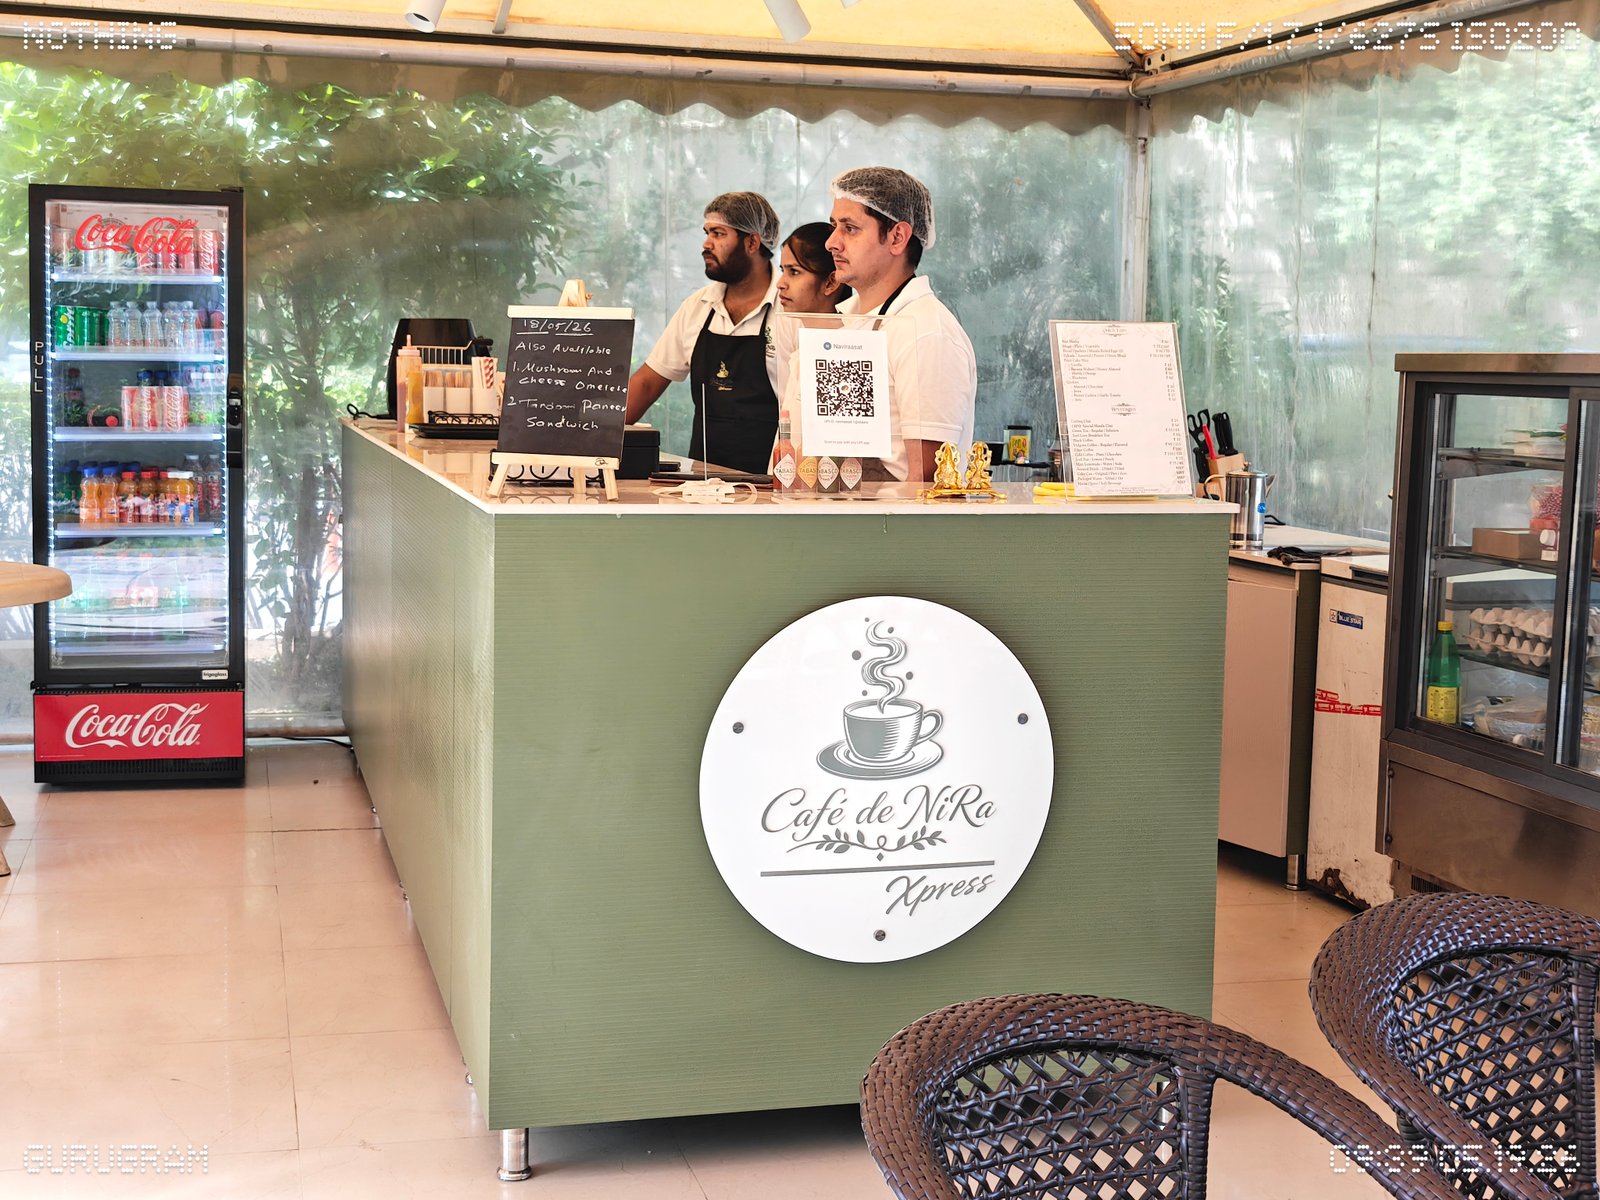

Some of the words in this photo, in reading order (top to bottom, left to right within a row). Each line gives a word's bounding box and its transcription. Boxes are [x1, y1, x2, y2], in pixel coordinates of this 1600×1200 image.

[515, 341, 546, 351] Also
[523, 319, 593, 333] 18/05/26
[34, 341, 44, 393] PULL
[587, 366, 612, 377] And
[65, 702, 210, 749] Coca-Cola
[761, 787, 848, 842] Café
[855, 791, 896, 824] de
[897, 784, 997, 830] NiRa
[885, 874, 996, 917] Xpress
